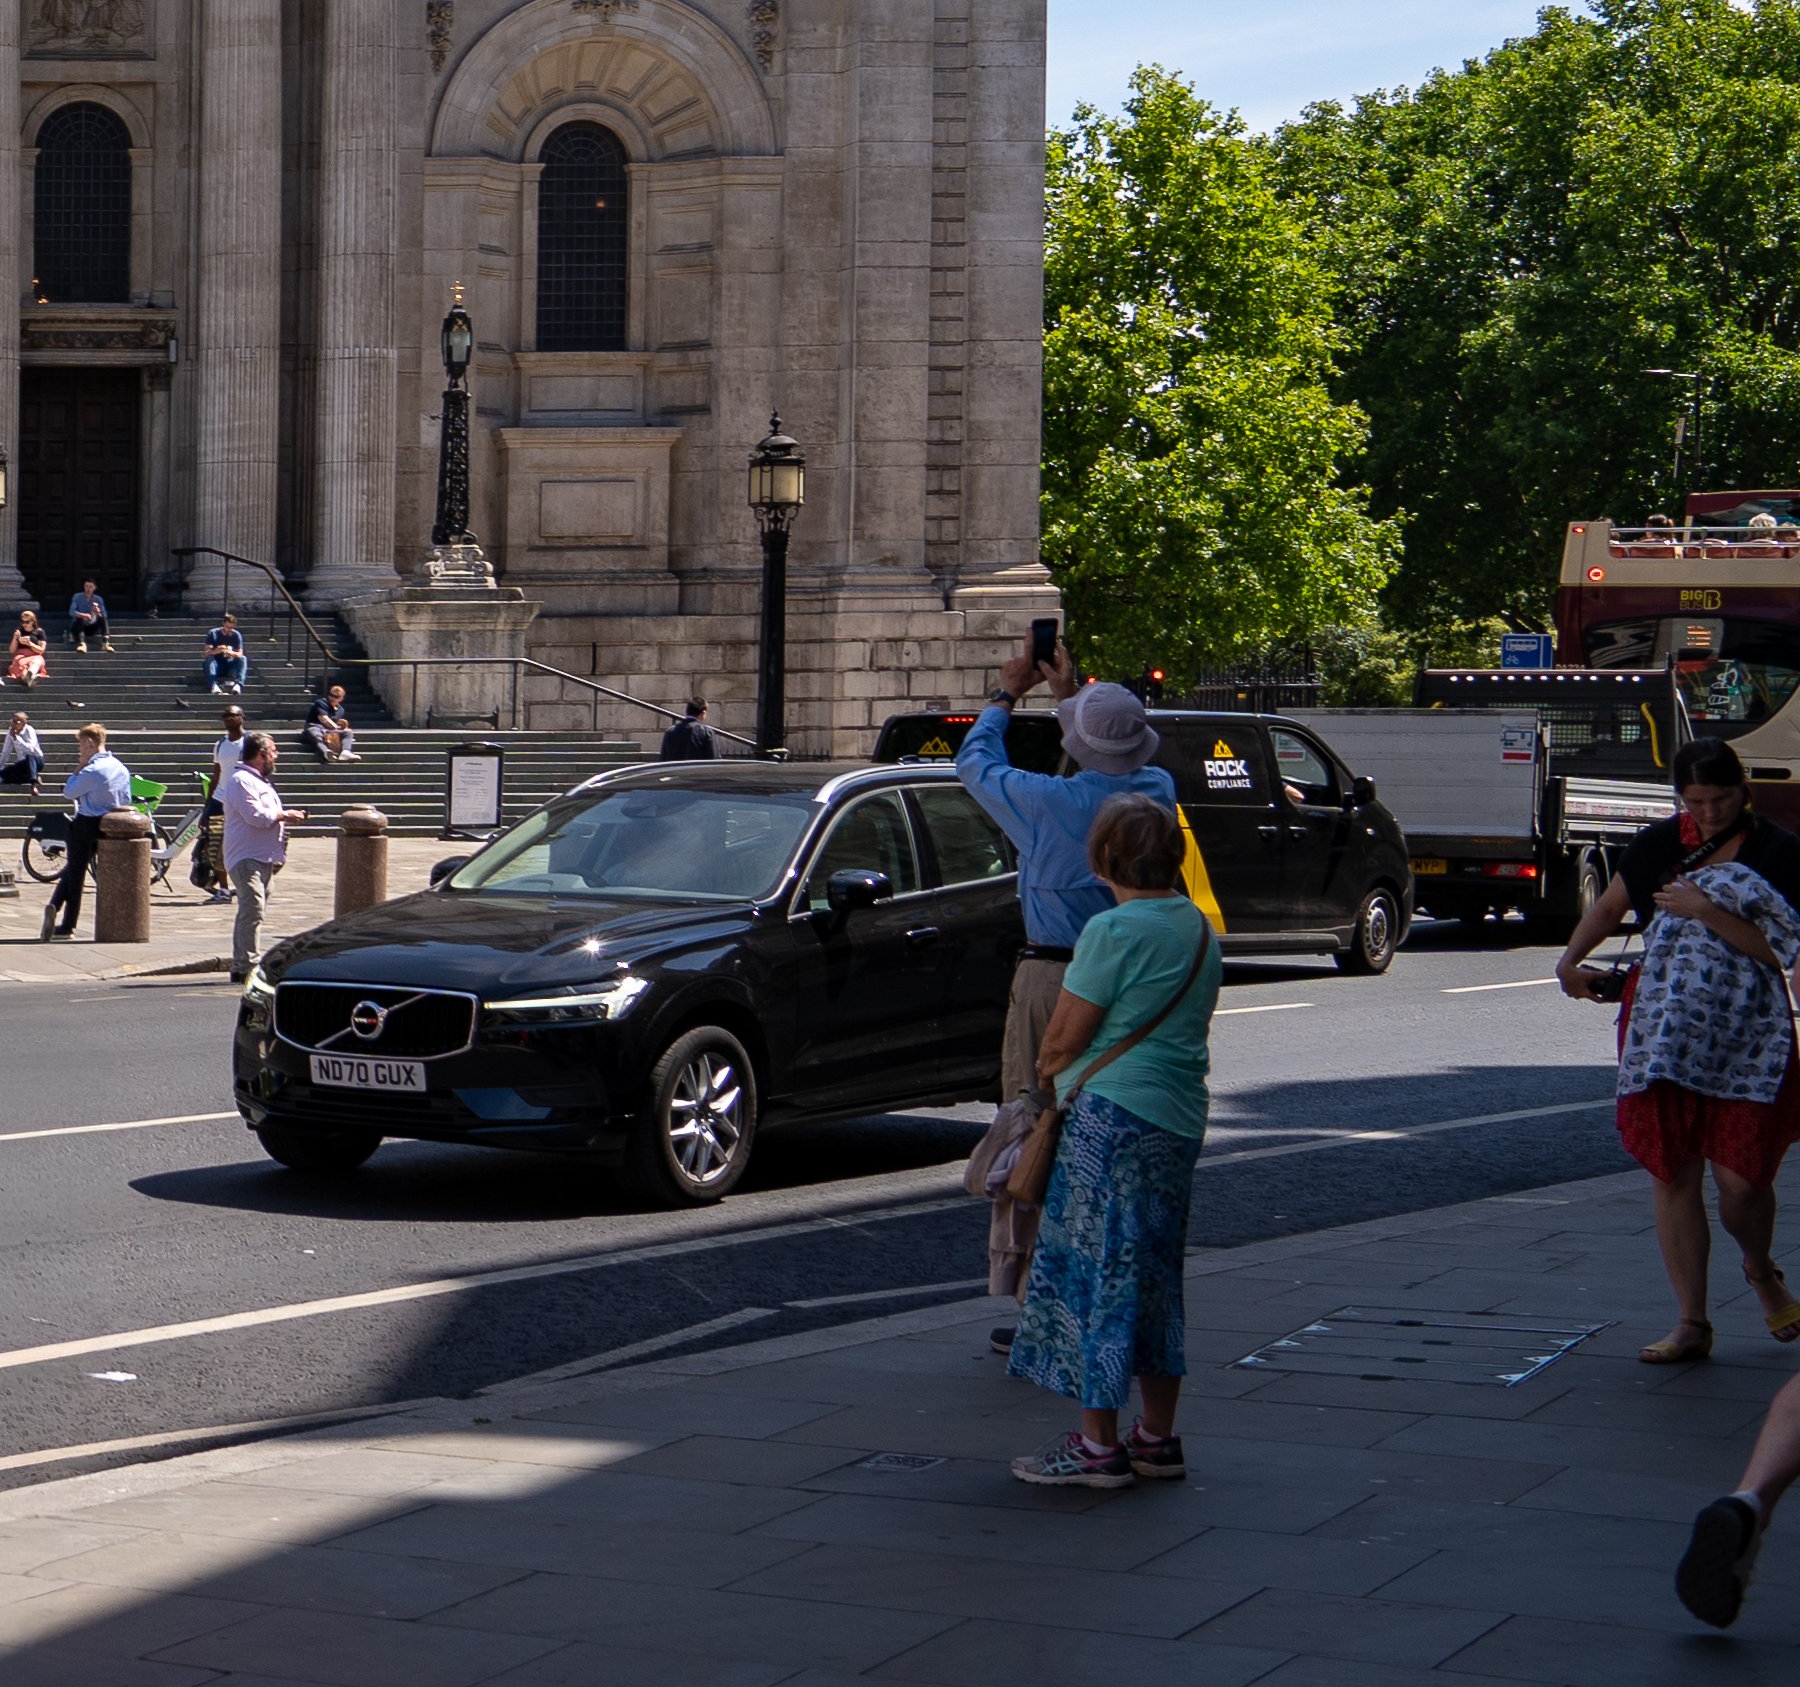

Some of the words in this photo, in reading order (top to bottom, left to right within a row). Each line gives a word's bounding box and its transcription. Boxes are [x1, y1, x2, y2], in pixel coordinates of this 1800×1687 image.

[1203, 759, 1249, 777] ROCK
[1207, 778, 1252, 789] COMPLIANCE
[318, 1058, 369, 1084] ND70
[374, 1063, 416, 1087] GUX
